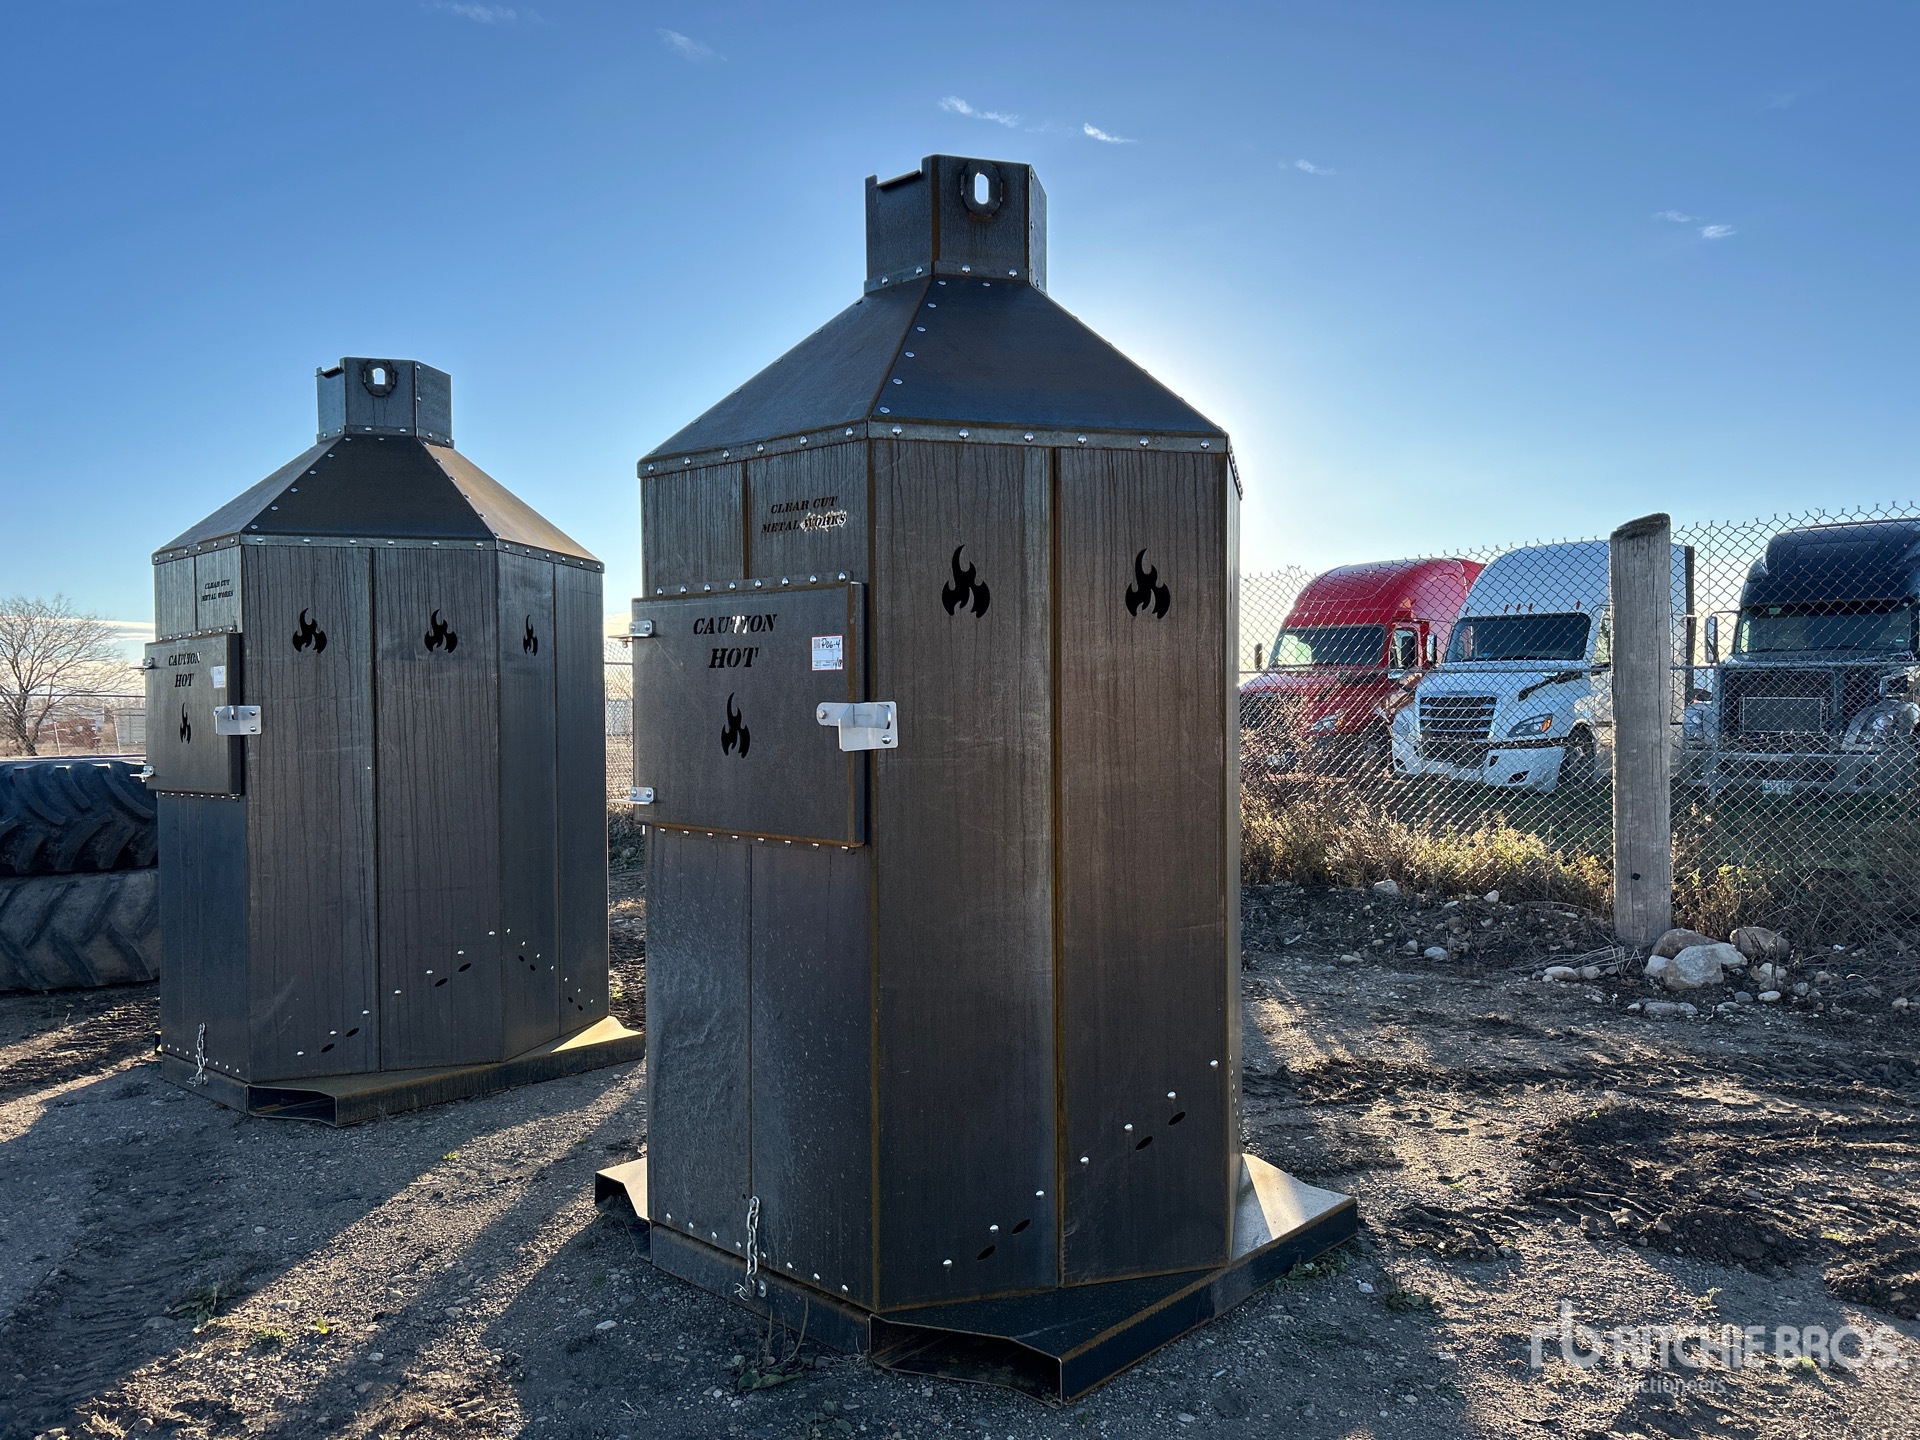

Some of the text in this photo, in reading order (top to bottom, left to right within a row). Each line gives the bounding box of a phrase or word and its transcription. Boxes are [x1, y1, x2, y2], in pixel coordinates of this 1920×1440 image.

[771, 495, 838, 514] CLEAR CUT
[761, 511, 847, 533] METAL WORKS
[693, 614, 777, 635] CAUTION
[168, 651, 202, 666] CAUTION
[708, 647, 759, 668] HOT
[174, 673, 194, 687] HOT
